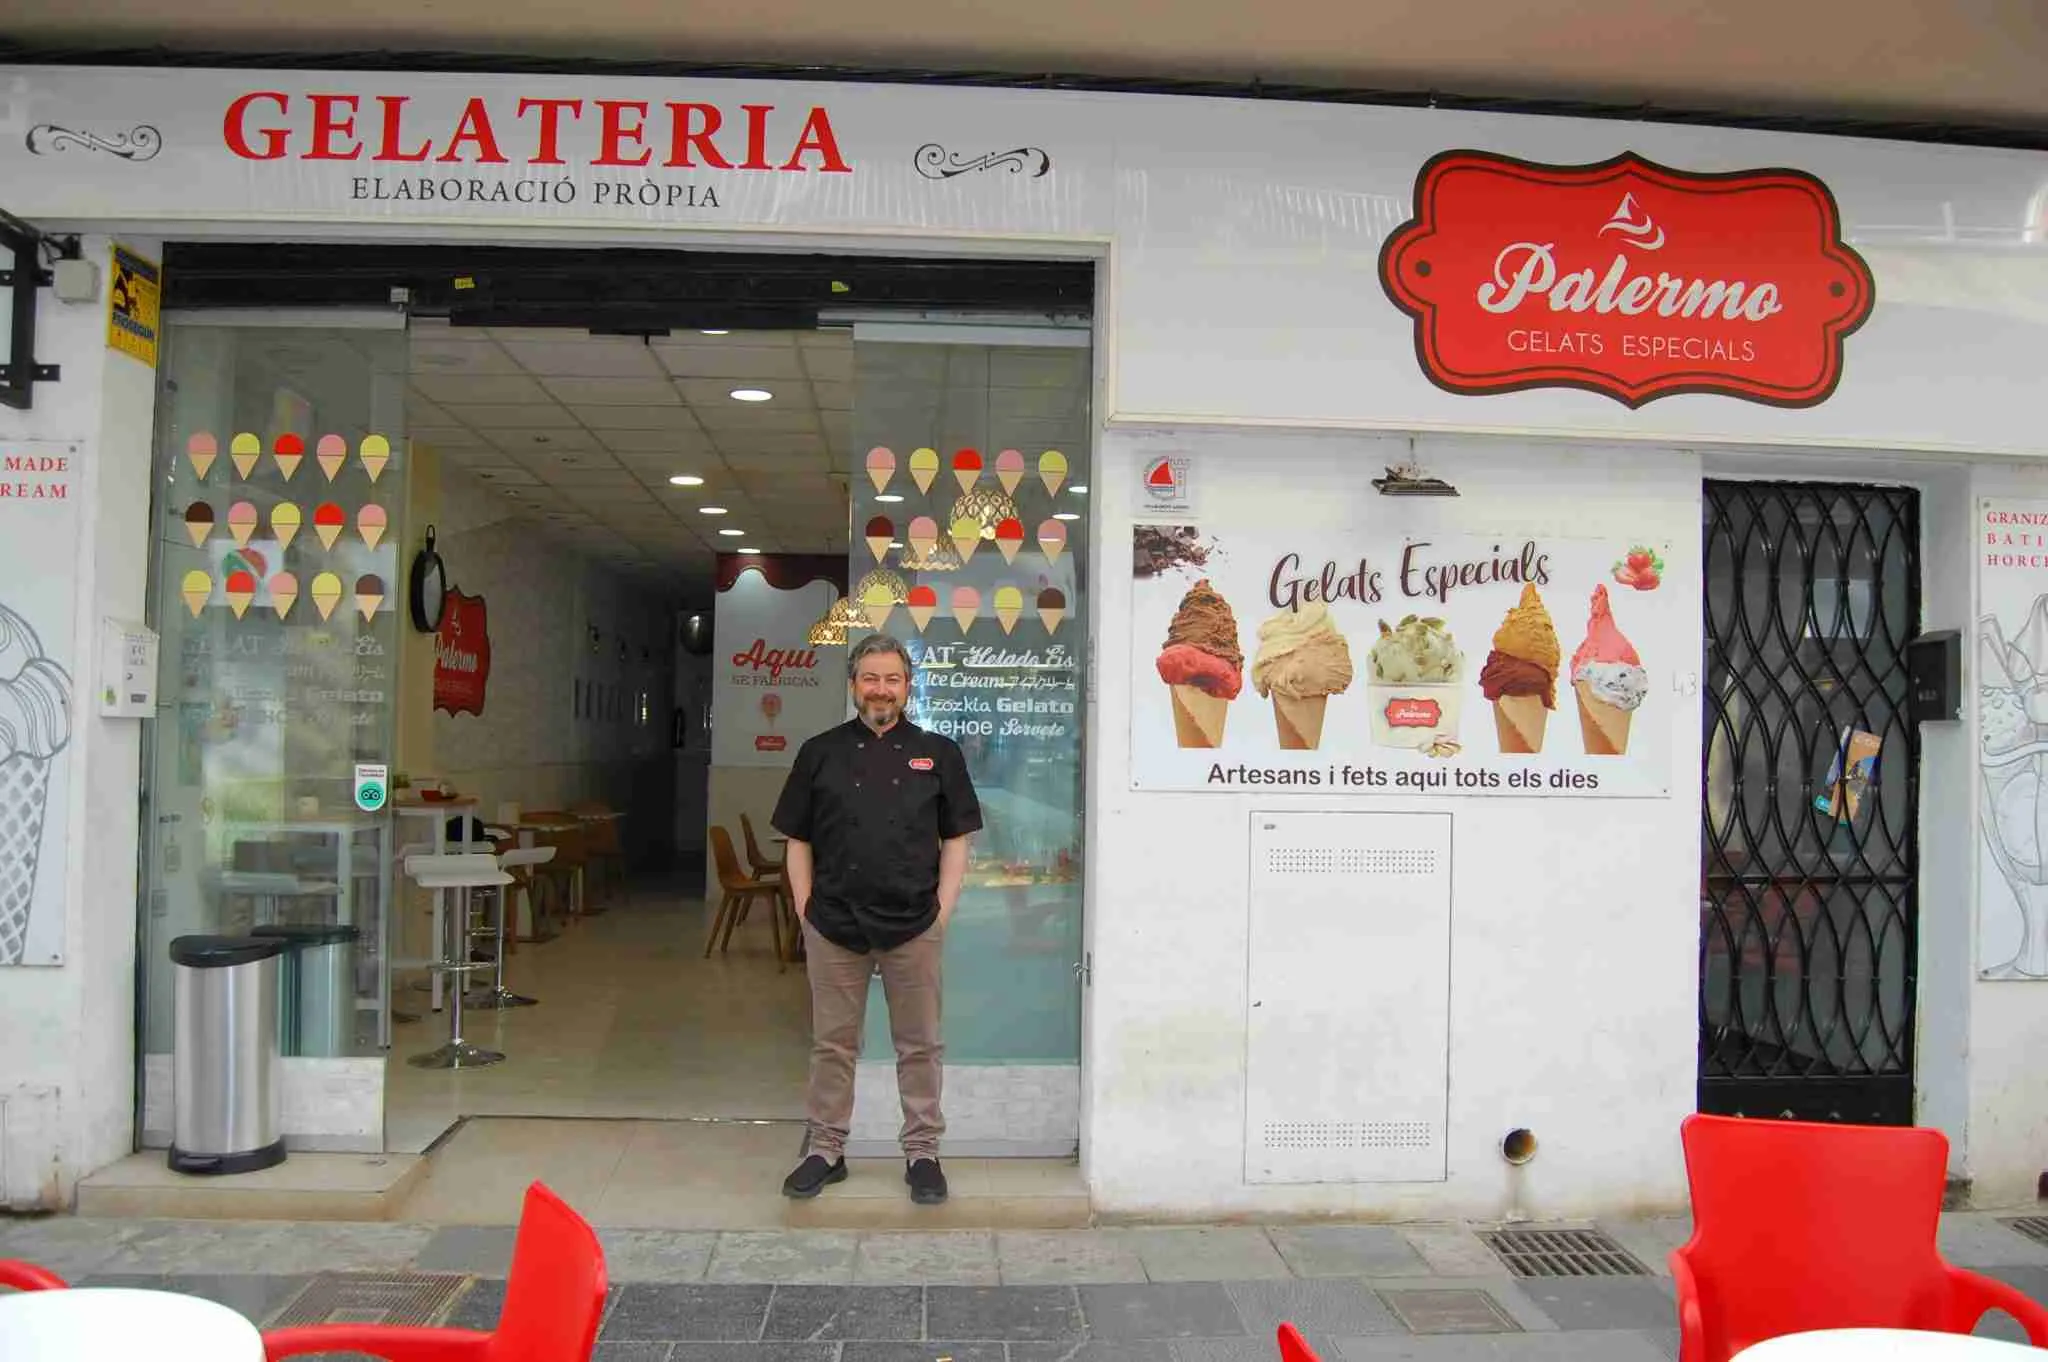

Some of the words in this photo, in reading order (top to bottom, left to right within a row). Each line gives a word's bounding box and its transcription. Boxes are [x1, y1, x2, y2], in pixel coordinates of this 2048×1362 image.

[222, 91, 853, 173] GELATERIA
[351, 176, 576, 203] ELABORACIÓ
[593, 180, 721, 208] PRÒPIA
[1477, 242, 1783, 321] Palermo
[1507, 330, 1603, 354] GELATS
[1622, 336, 1755, 362] ESPECIALS
[4, 456, 69, 471] MADE
[1269, 553, 1382, 613] Gelats
[1400, 540, 1550, 604] Especials
[906, 645, 955, 664] LAT
[997, 697, 1075, 714] Gelato
[1207, 763, 1321, 785] Artesans
[1329, 765, 1335, 785] i
[1341, 765, 1388, 787] fets
[1395, 766, 1447, 791] aqui
[1454, 768, 1501, 788] tots
[1507, 767, 1543, 789] els
[1549, 768, 1599, 789] dies
